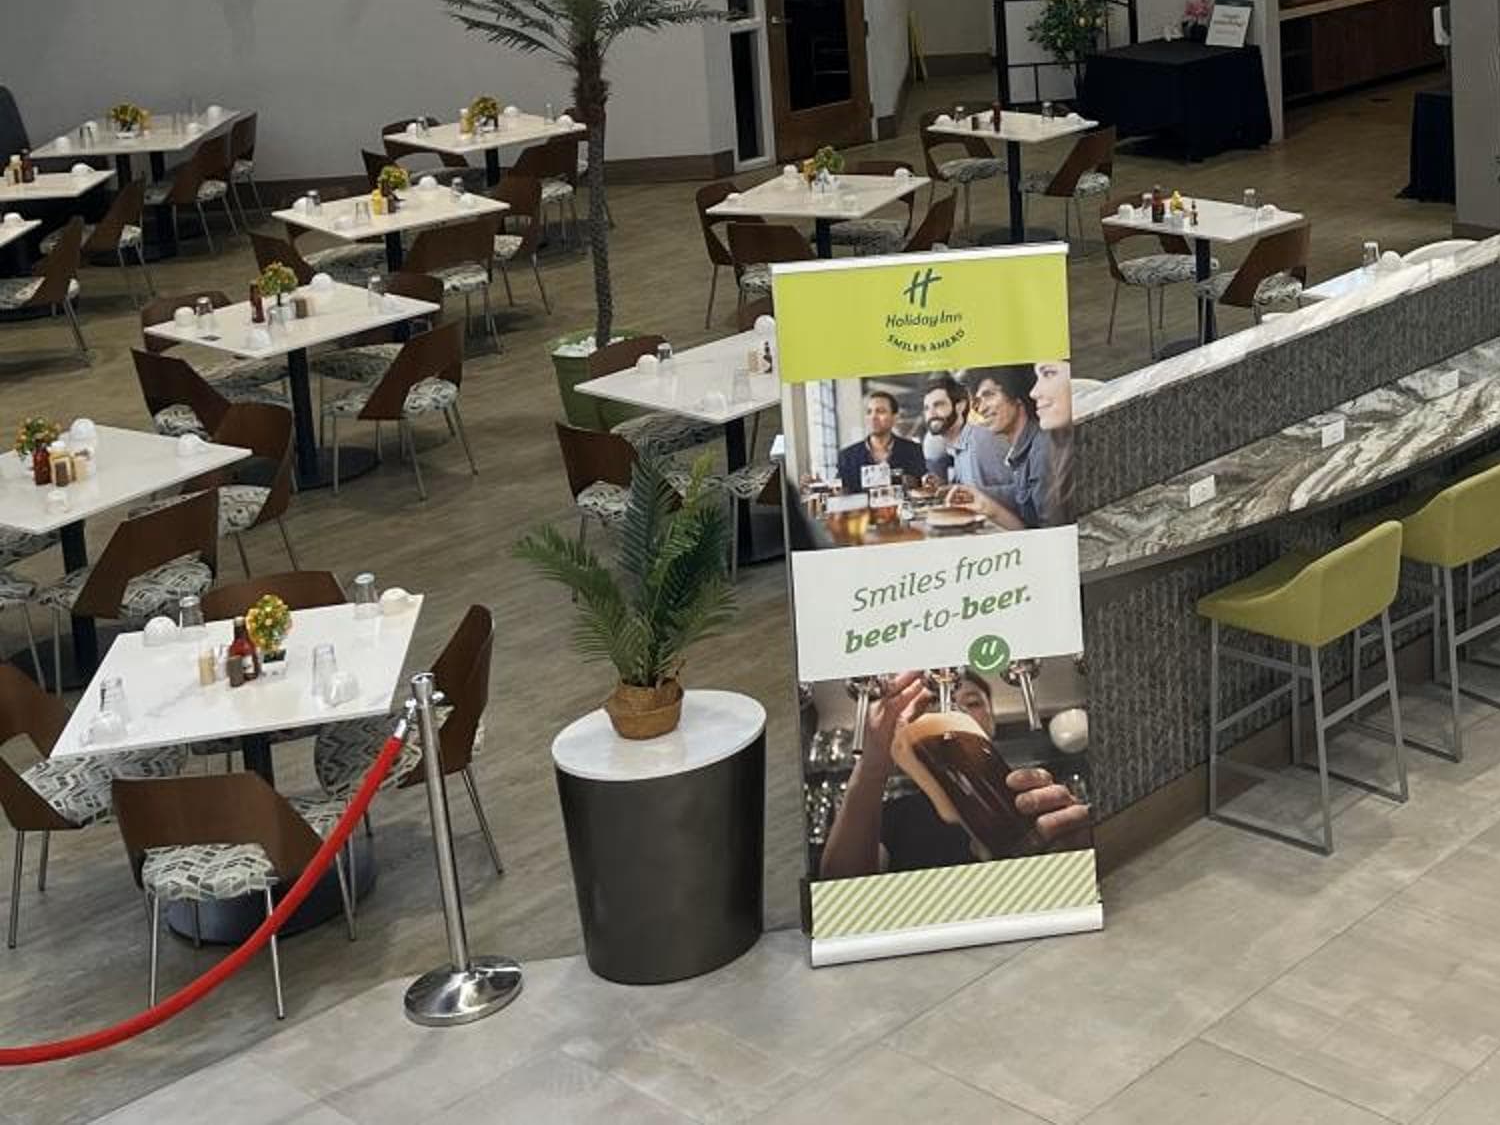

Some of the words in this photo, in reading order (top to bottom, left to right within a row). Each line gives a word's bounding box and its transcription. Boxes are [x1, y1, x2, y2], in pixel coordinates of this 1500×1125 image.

[885, 313, 938, 328] Holiday
[940, 309, 963, 324] Inn
[887, 334, 927, 352] SMILES
[929, 326, 965, 352] AHEAD
[852, 570, 946, 612] Smiles
[955, 547, 1022, 584] from
[844, 584, 1032, 654] beer-to-beer.
